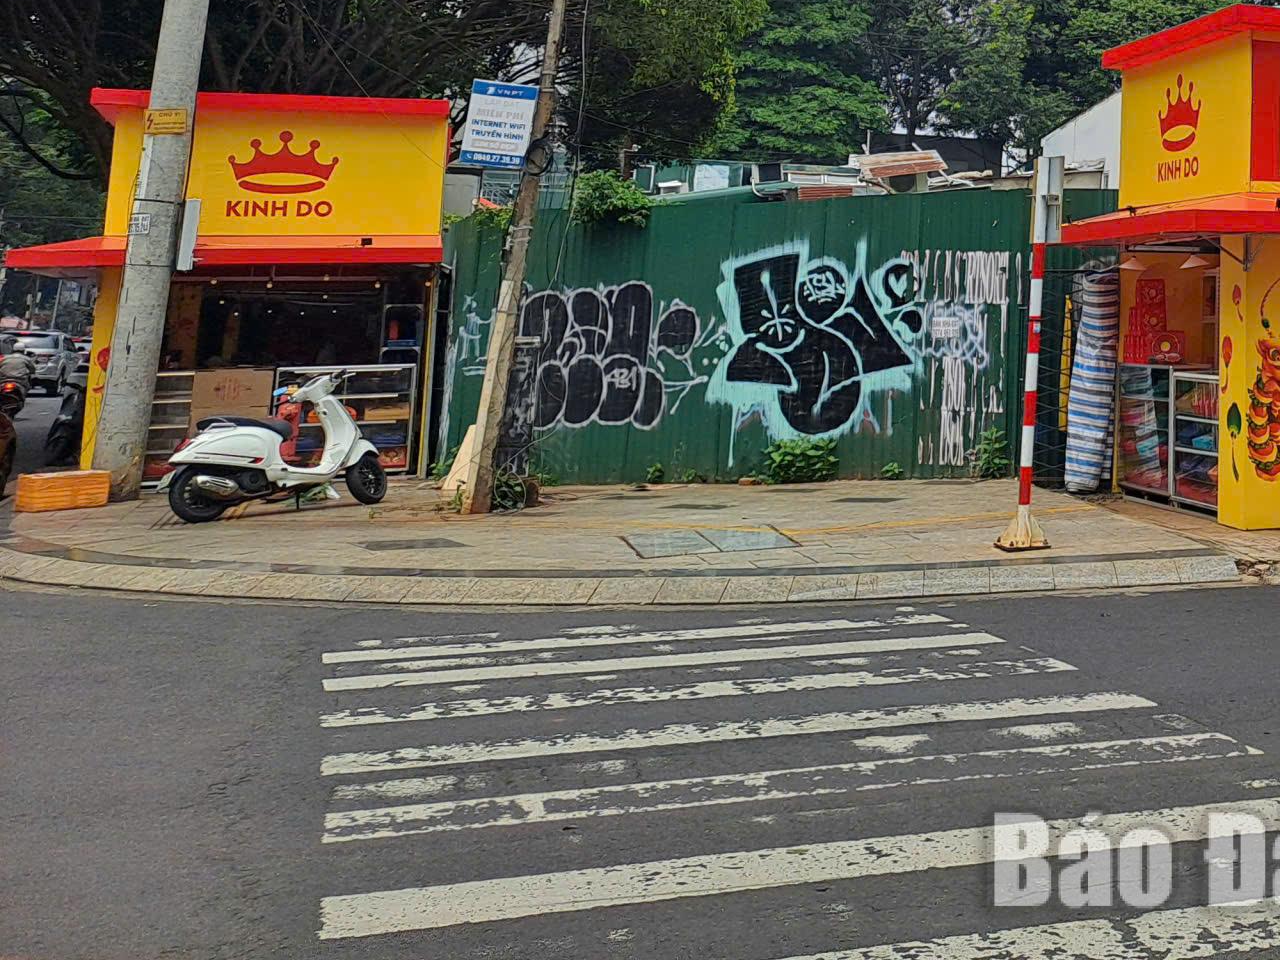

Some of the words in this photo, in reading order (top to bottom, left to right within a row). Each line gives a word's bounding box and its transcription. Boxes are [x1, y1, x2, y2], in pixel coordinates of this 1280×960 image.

[497, 88, 524, 97] VNPT
[471, 119, 508, 129] INTERNET
[1157, 159, 1182, 182] KINH
[1183, 156, 1200, 179] DO
[225, 200, 289, 217] KINH
[295, 200, 333, 218] DO
